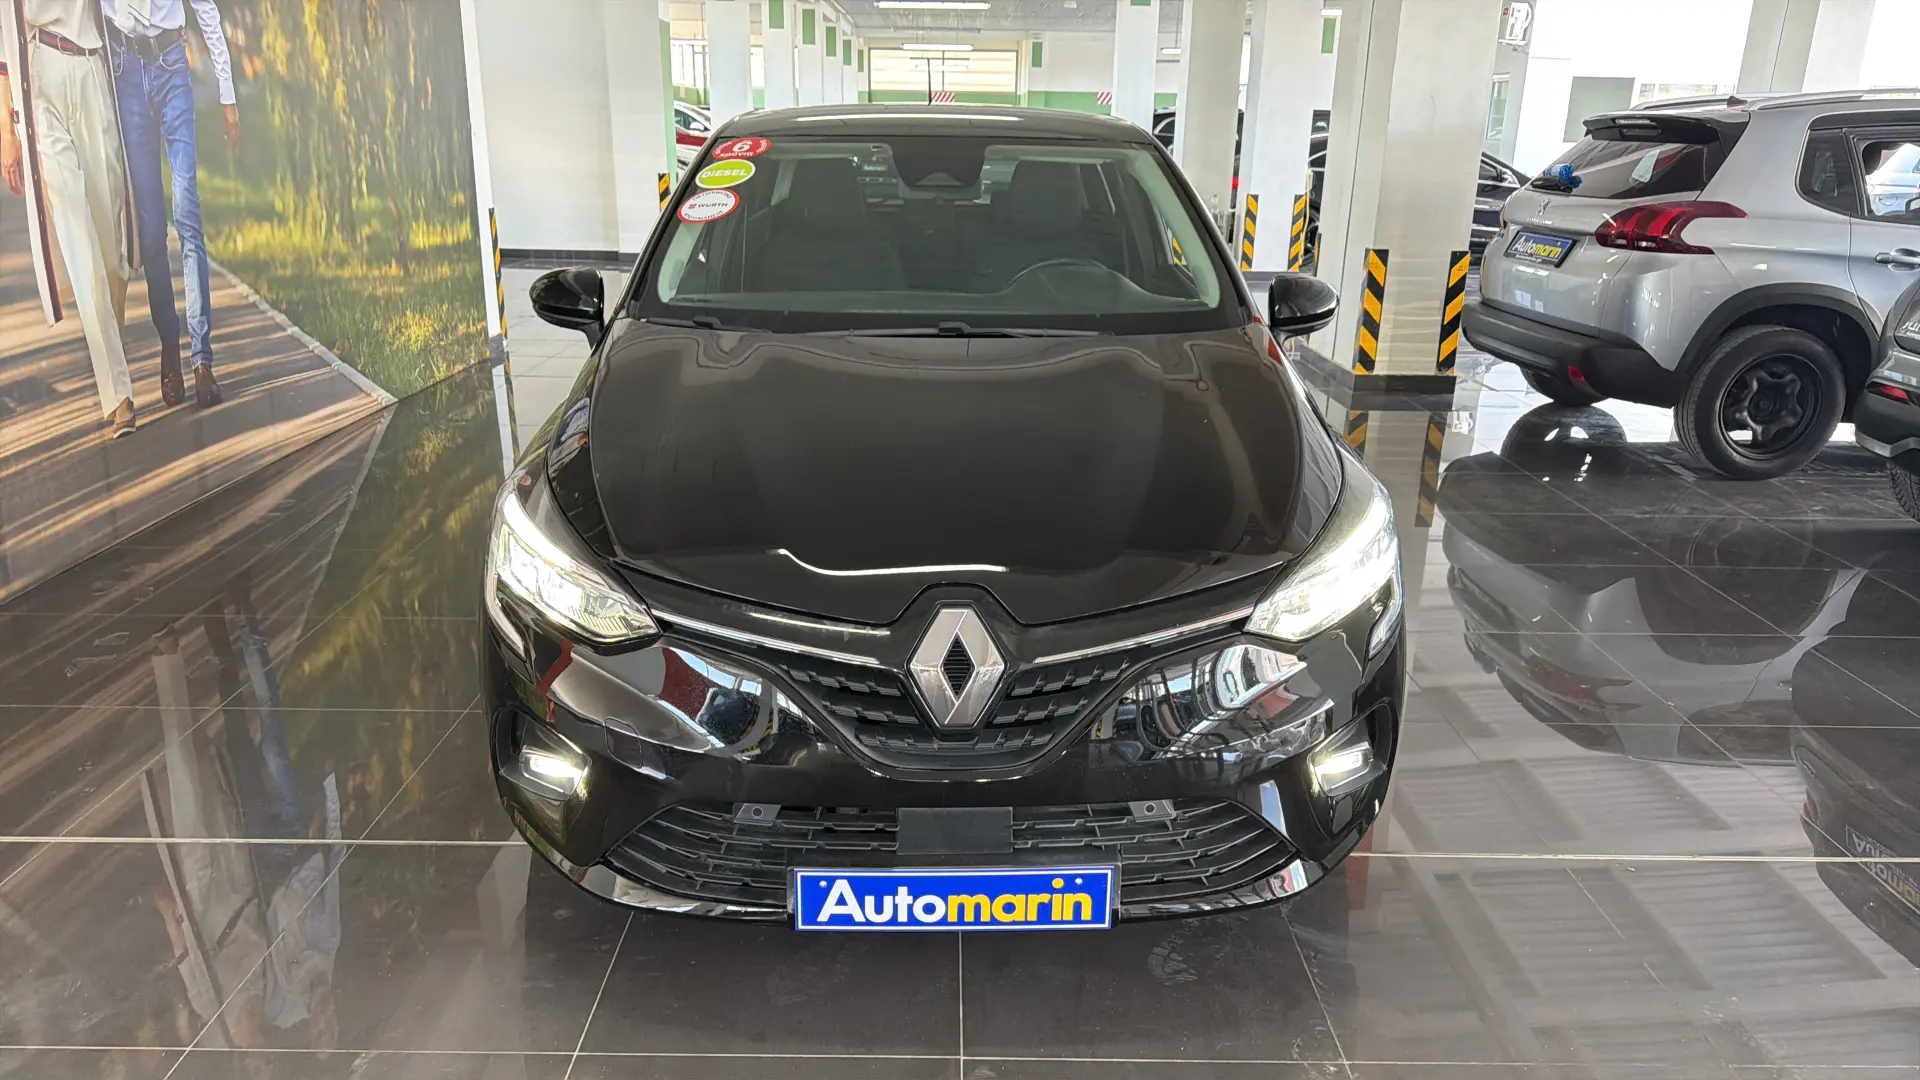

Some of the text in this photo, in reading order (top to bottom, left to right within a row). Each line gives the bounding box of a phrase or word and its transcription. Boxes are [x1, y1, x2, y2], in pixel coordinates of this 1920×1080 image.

[732, 140, 753, 152] 6
[702, 169, 748, 177] DIESEL
[1512, 235, 1561, 258] Automarin
[816, 878, 1092, 922] Automarin
